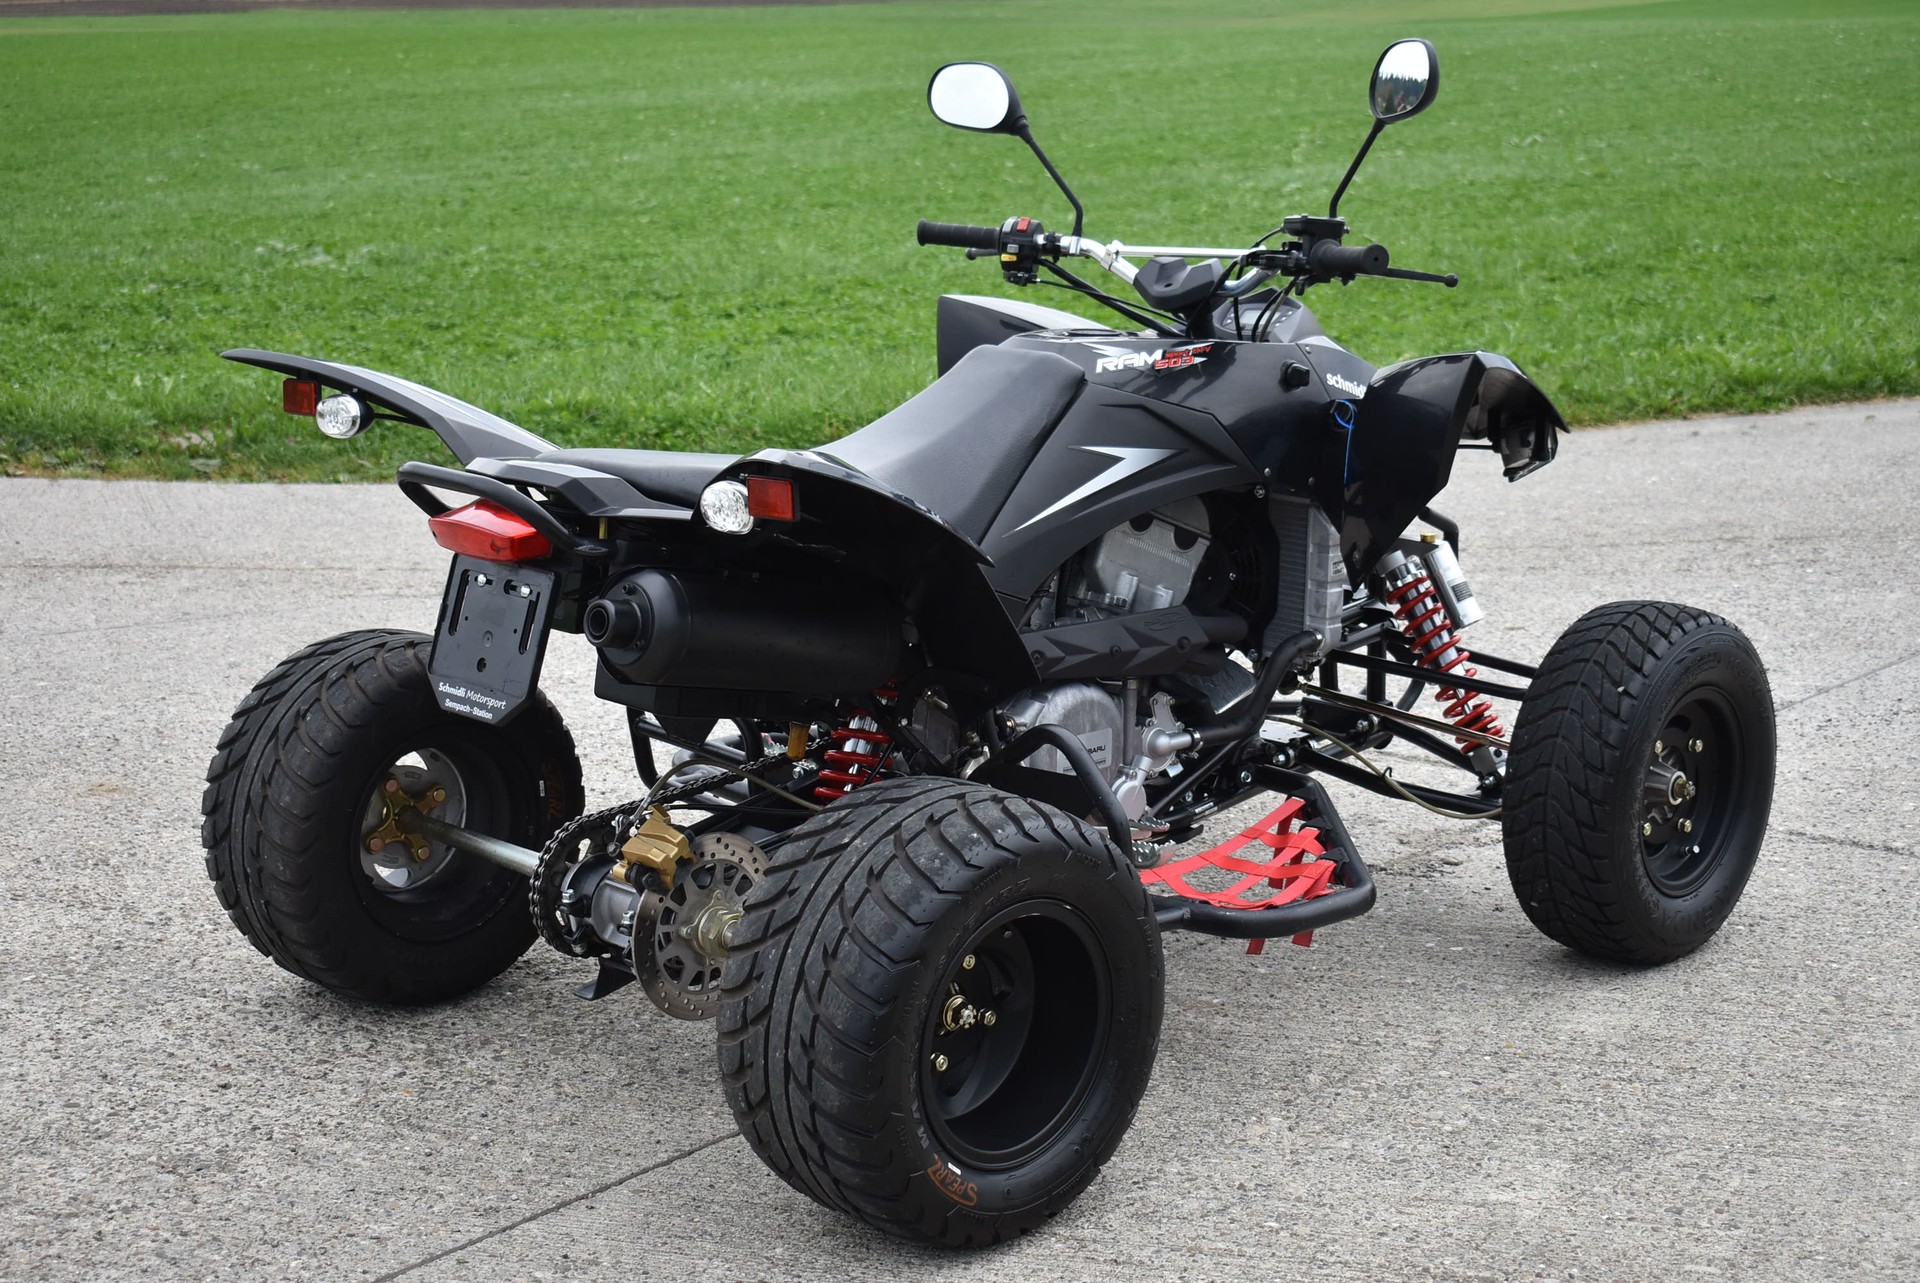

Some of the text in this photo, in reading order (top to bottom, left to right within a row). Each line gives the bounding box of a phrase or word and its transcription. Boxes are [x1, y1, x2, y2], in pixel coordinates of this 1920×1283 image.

[1095, 349, 1195, 373] RAM 503
[438, 682, 507, 710] Schmidli Motorsport
[444, 698, 493, 720] Sempach-Station
[1087, 744, 1106, 755] BARU
